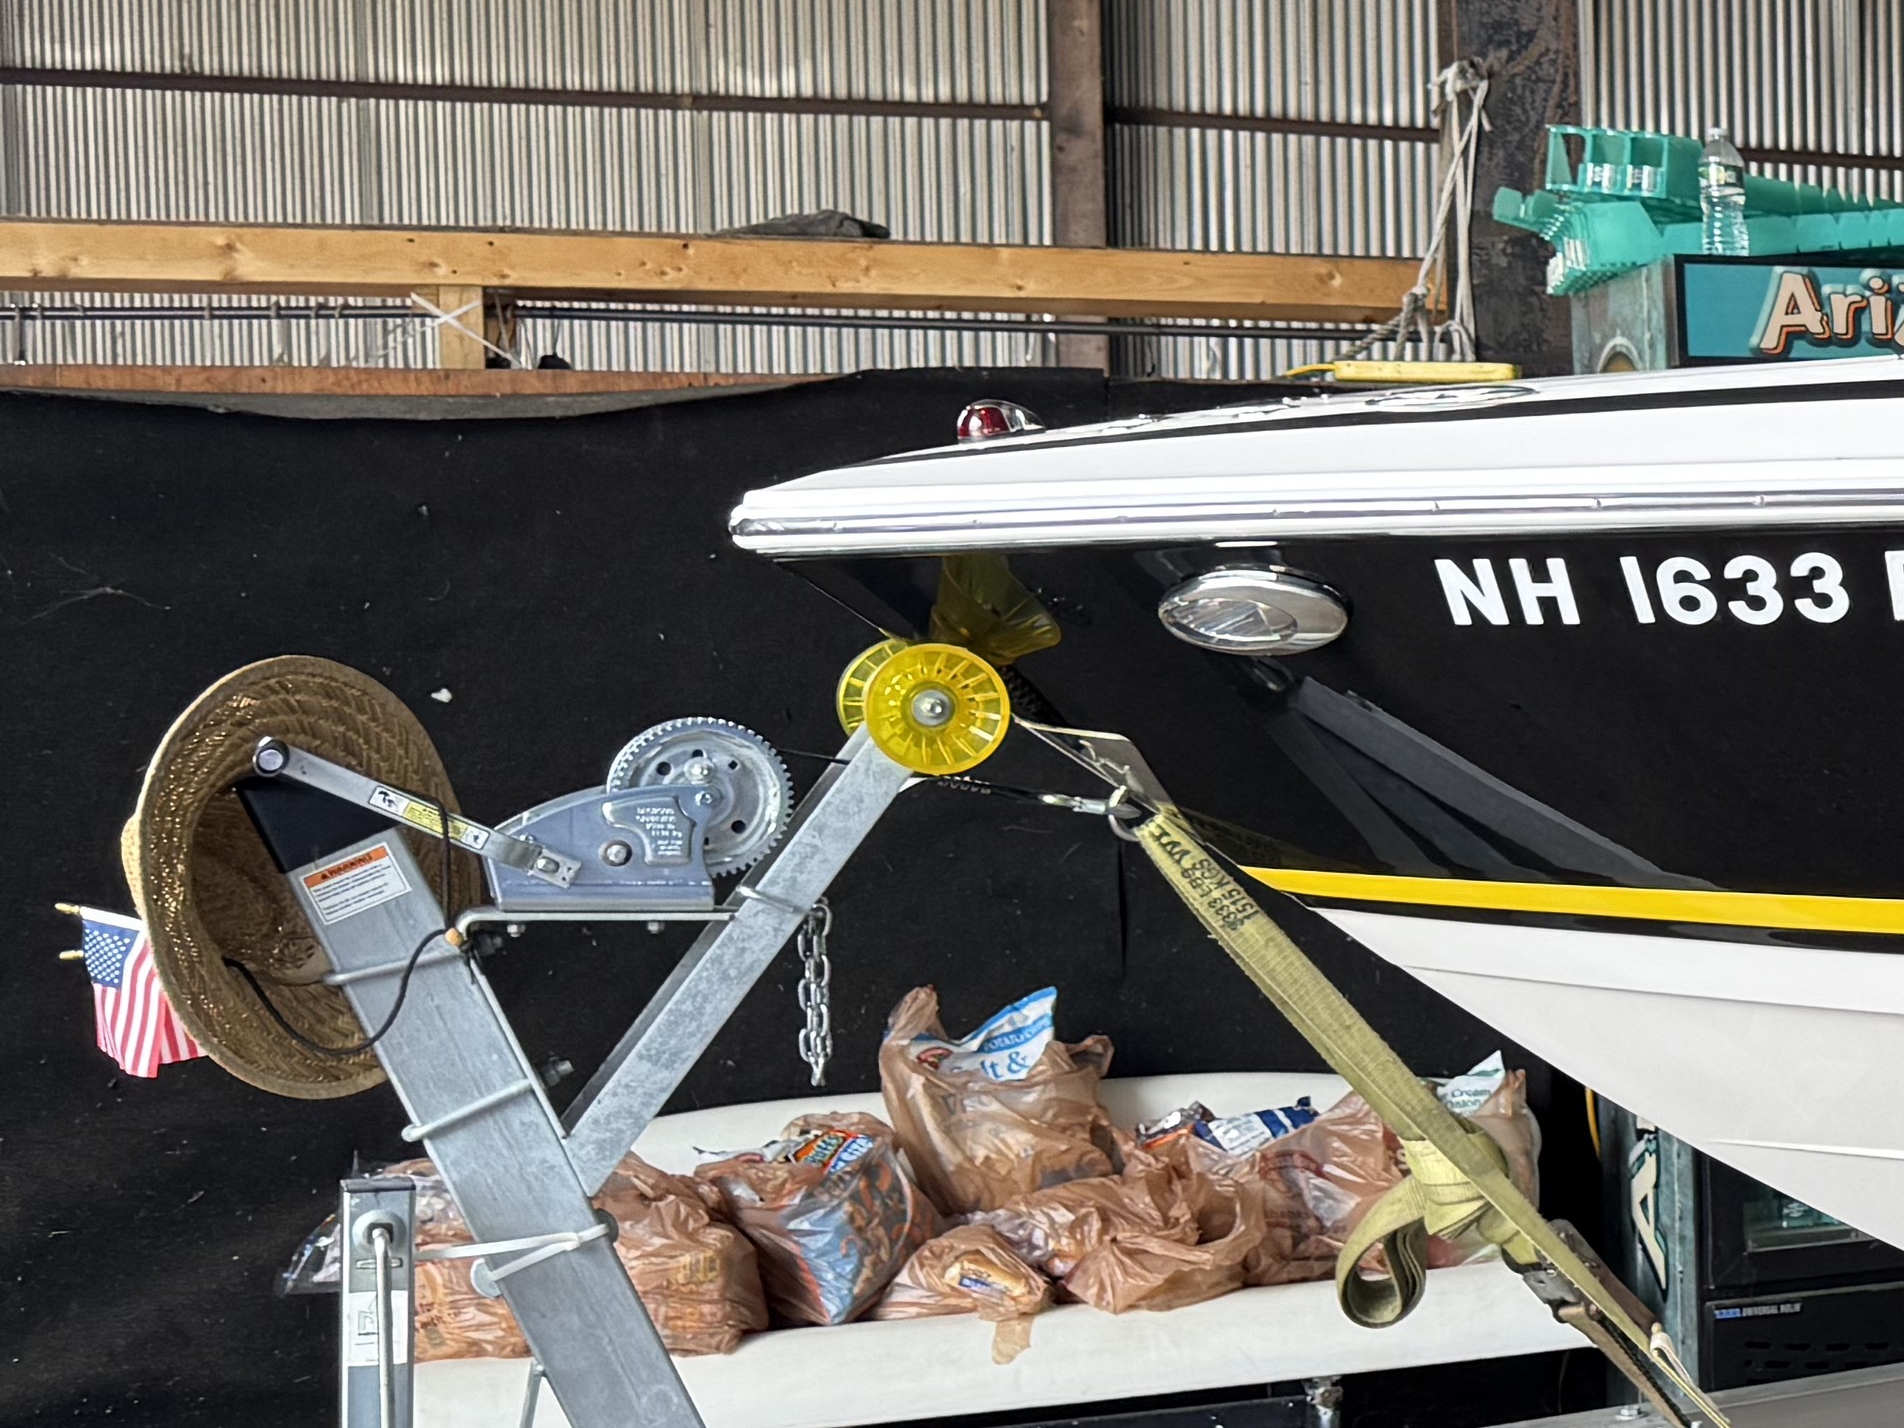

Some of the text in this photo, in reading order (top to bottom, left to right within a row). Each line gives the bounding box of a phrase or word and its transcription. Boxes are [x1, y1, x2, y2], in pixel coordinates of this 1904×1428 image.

[1434, 557, 1582, 626] NH
[1620, 552, 1850, 626] 1633
[1192, 858, 1260, 920] 1515 KGS
